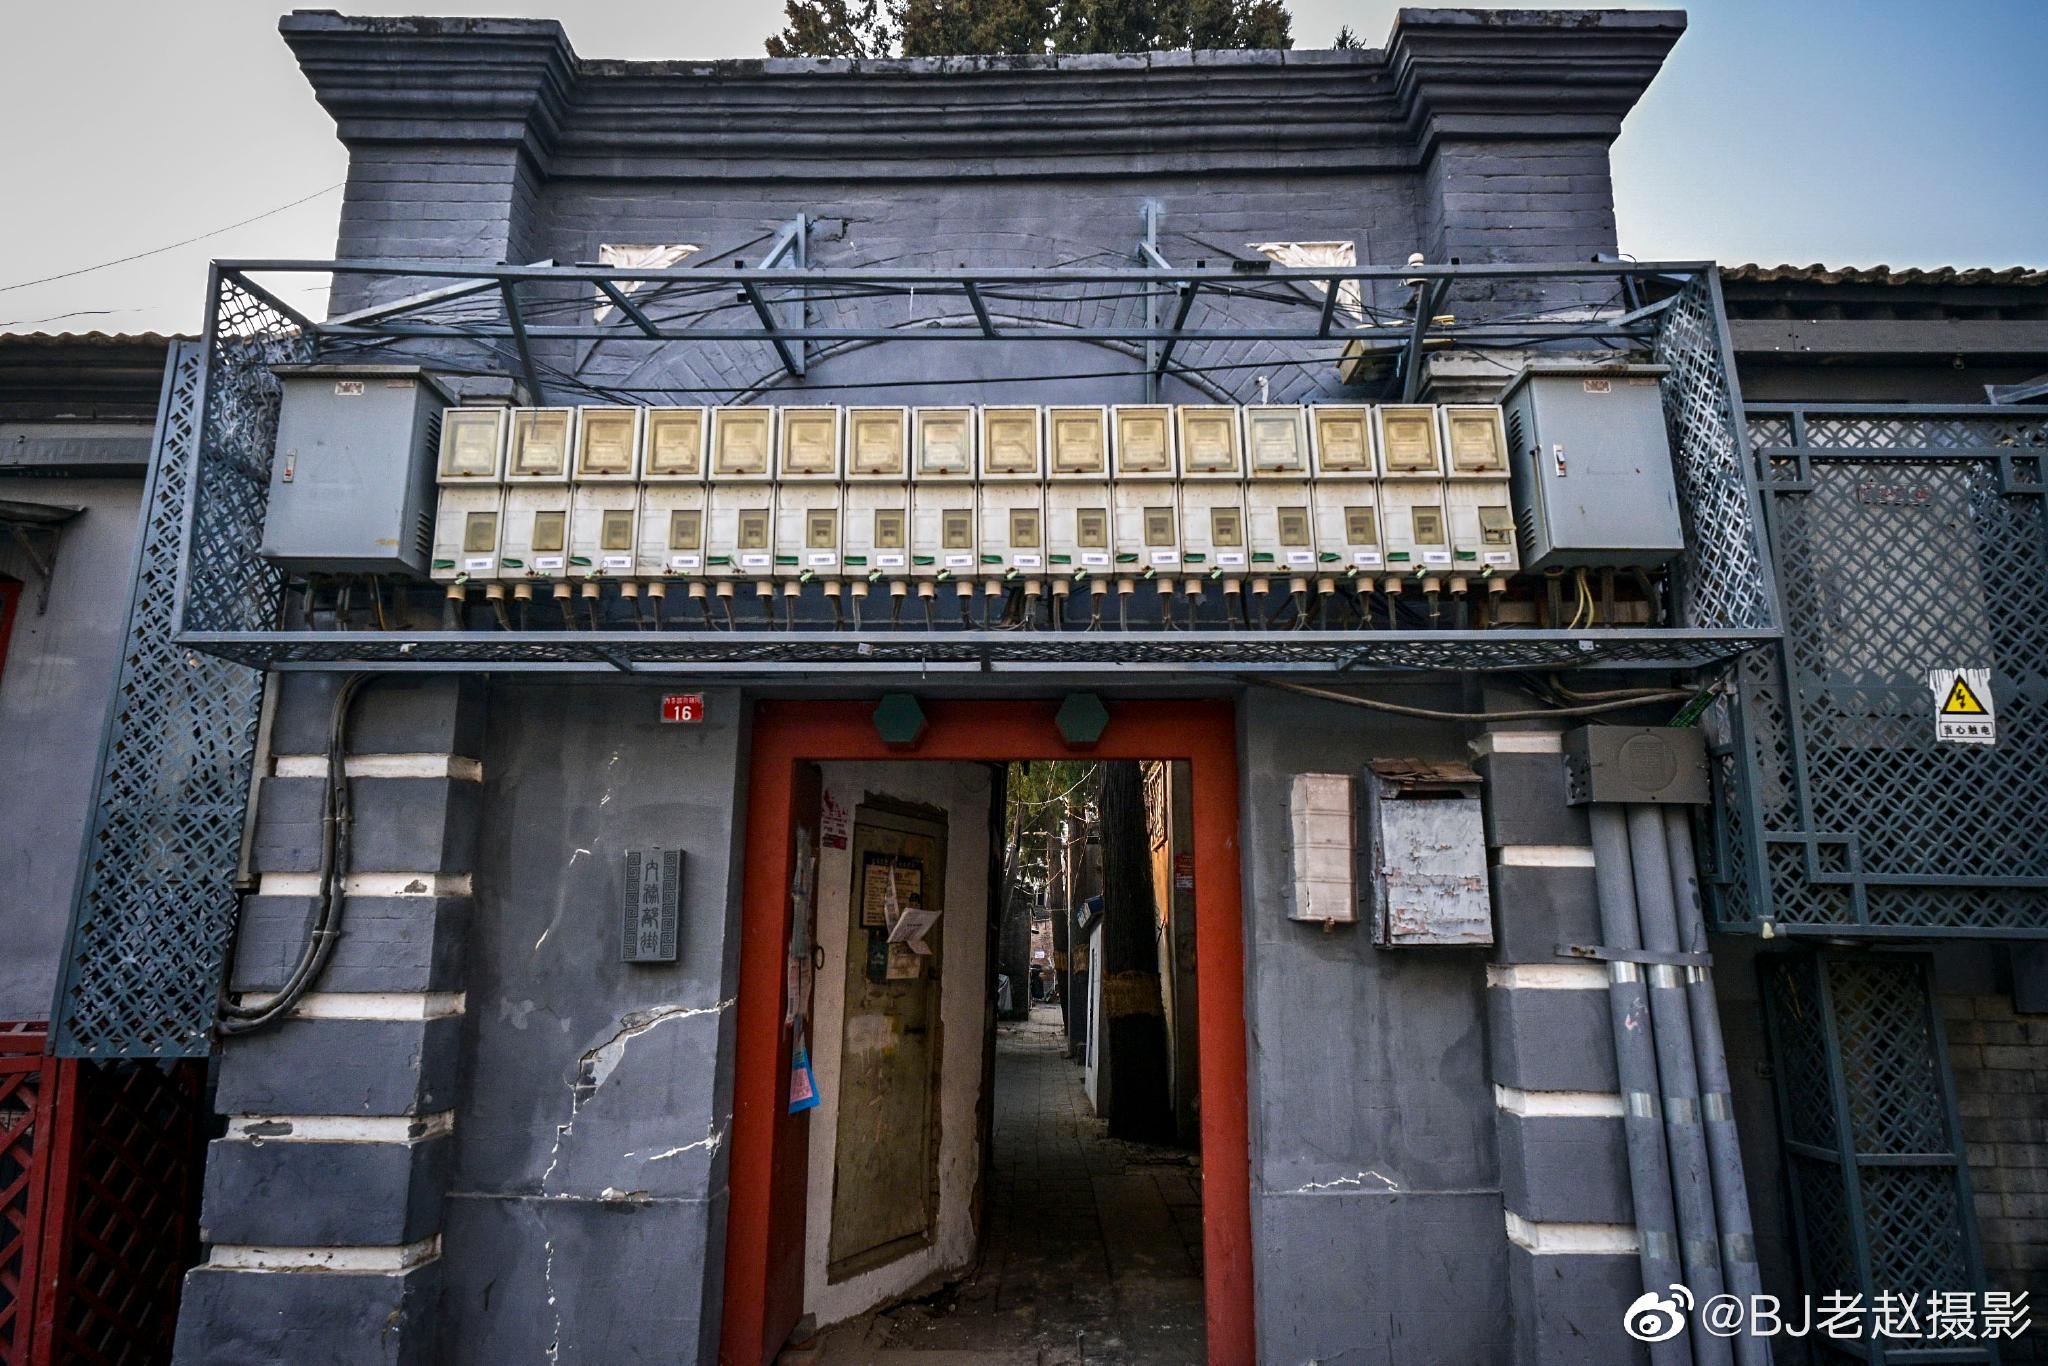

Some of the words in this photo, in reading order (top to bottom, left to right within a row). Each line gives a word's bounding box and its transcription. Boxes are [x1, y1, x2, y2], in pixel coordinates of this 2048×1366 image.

[674, 706, 692, 721] 16
[1943, 724, 1991, 736] 当心触电
